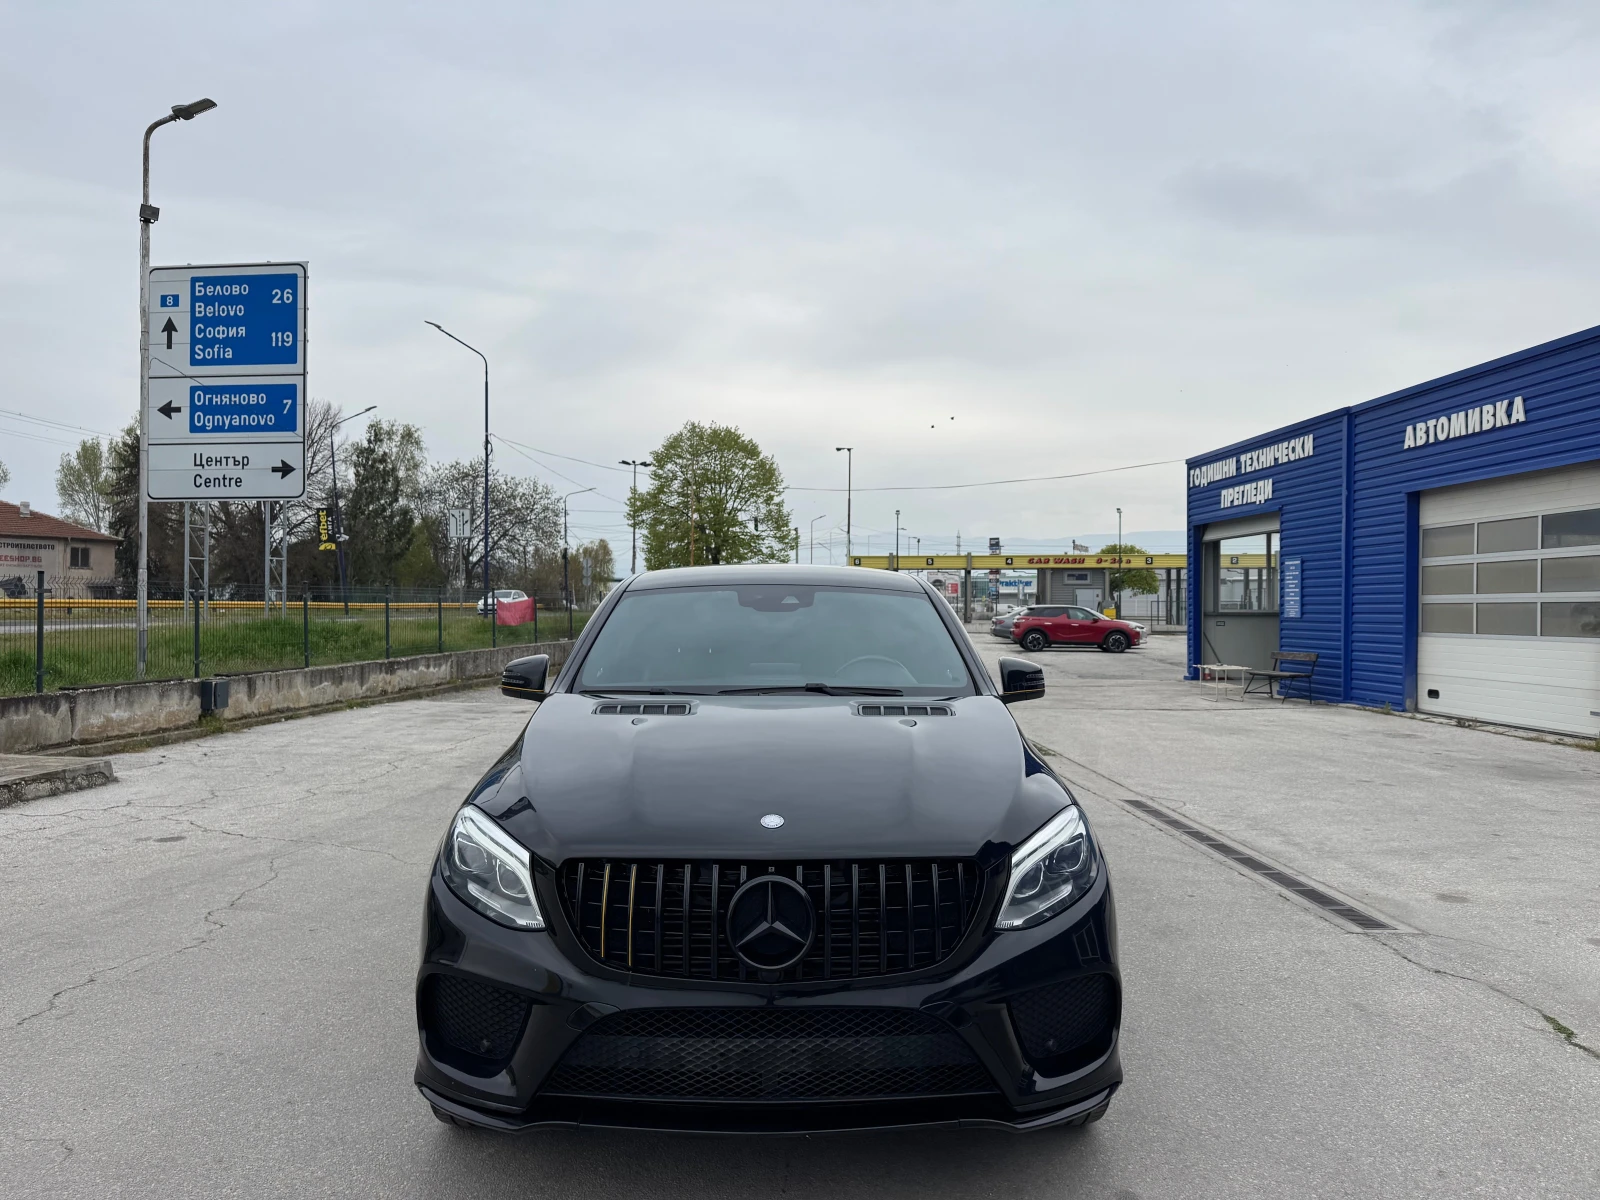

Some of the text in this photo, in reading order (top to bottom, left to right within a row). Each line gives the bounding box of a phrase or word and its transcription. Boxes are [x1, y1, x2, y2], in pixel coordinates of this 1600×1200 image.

[195, 282, 249, 296] Белово
[271, 289, 293, 304] 26
[166, 296, 174, 306] 8
[195, 302, 245, 317] Belovo
[195, 324, 246, 340] София
[271, 332, 293, 347] 119
[194, 345, 233, 360] Sofia
[194, 391, 267, 406] Огняново
[282, 400, 292, 414] 7
[194, 412, 275, 429] Ognyanovo
[1403, 395, 1526, 449] АВТОМИВКА
[193, 453, 250, 470] Център
[1189, 434, 1314, 487] ГОДИШНИ ТЕХНИЧЕСКИ
[193, 474, 243, 488] Centre
[1220, 478, 1273, 508] ПРЕГЛЕДИ
[319, 510, 328, 541] efbet
